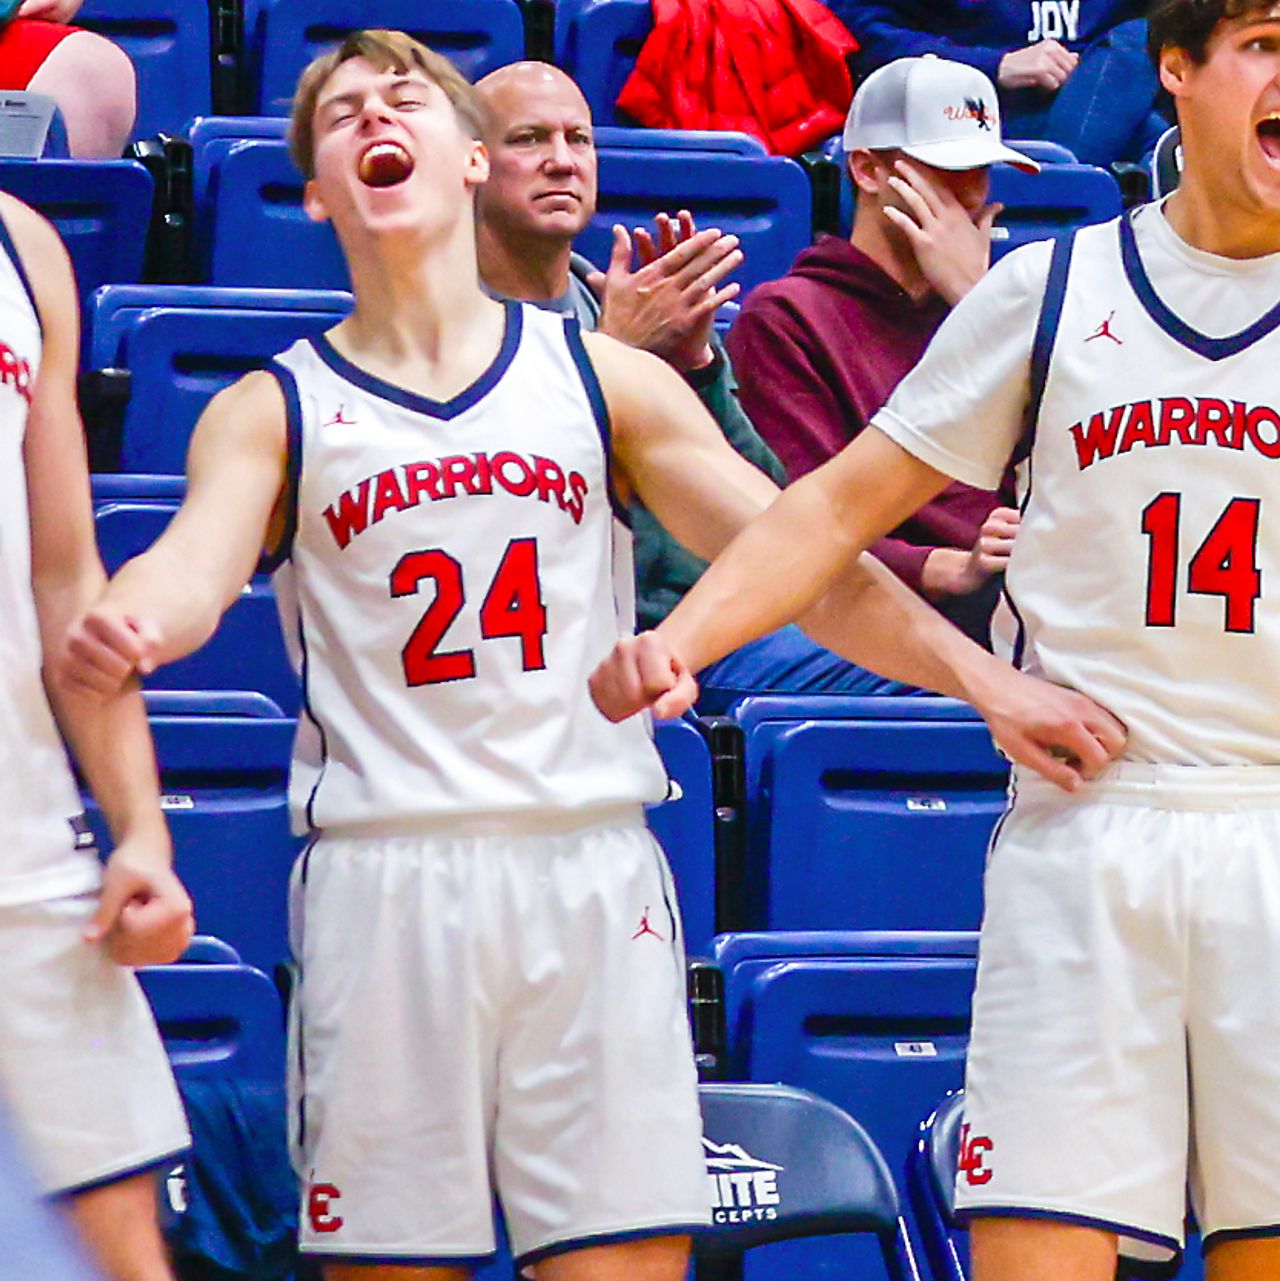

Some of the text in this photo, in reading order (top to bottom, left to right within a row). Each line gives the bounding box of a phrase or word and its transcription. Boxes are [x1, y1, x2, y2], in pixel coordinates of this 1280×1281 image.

[1027, 0, 1080, 42] JOY
[322, 452, 588, 550] WARRIORS
[1142, 492, 1262, 634] 14
[390, 537, 549, 688] 24
[714, 1207, 778, 1224] CEPTS
